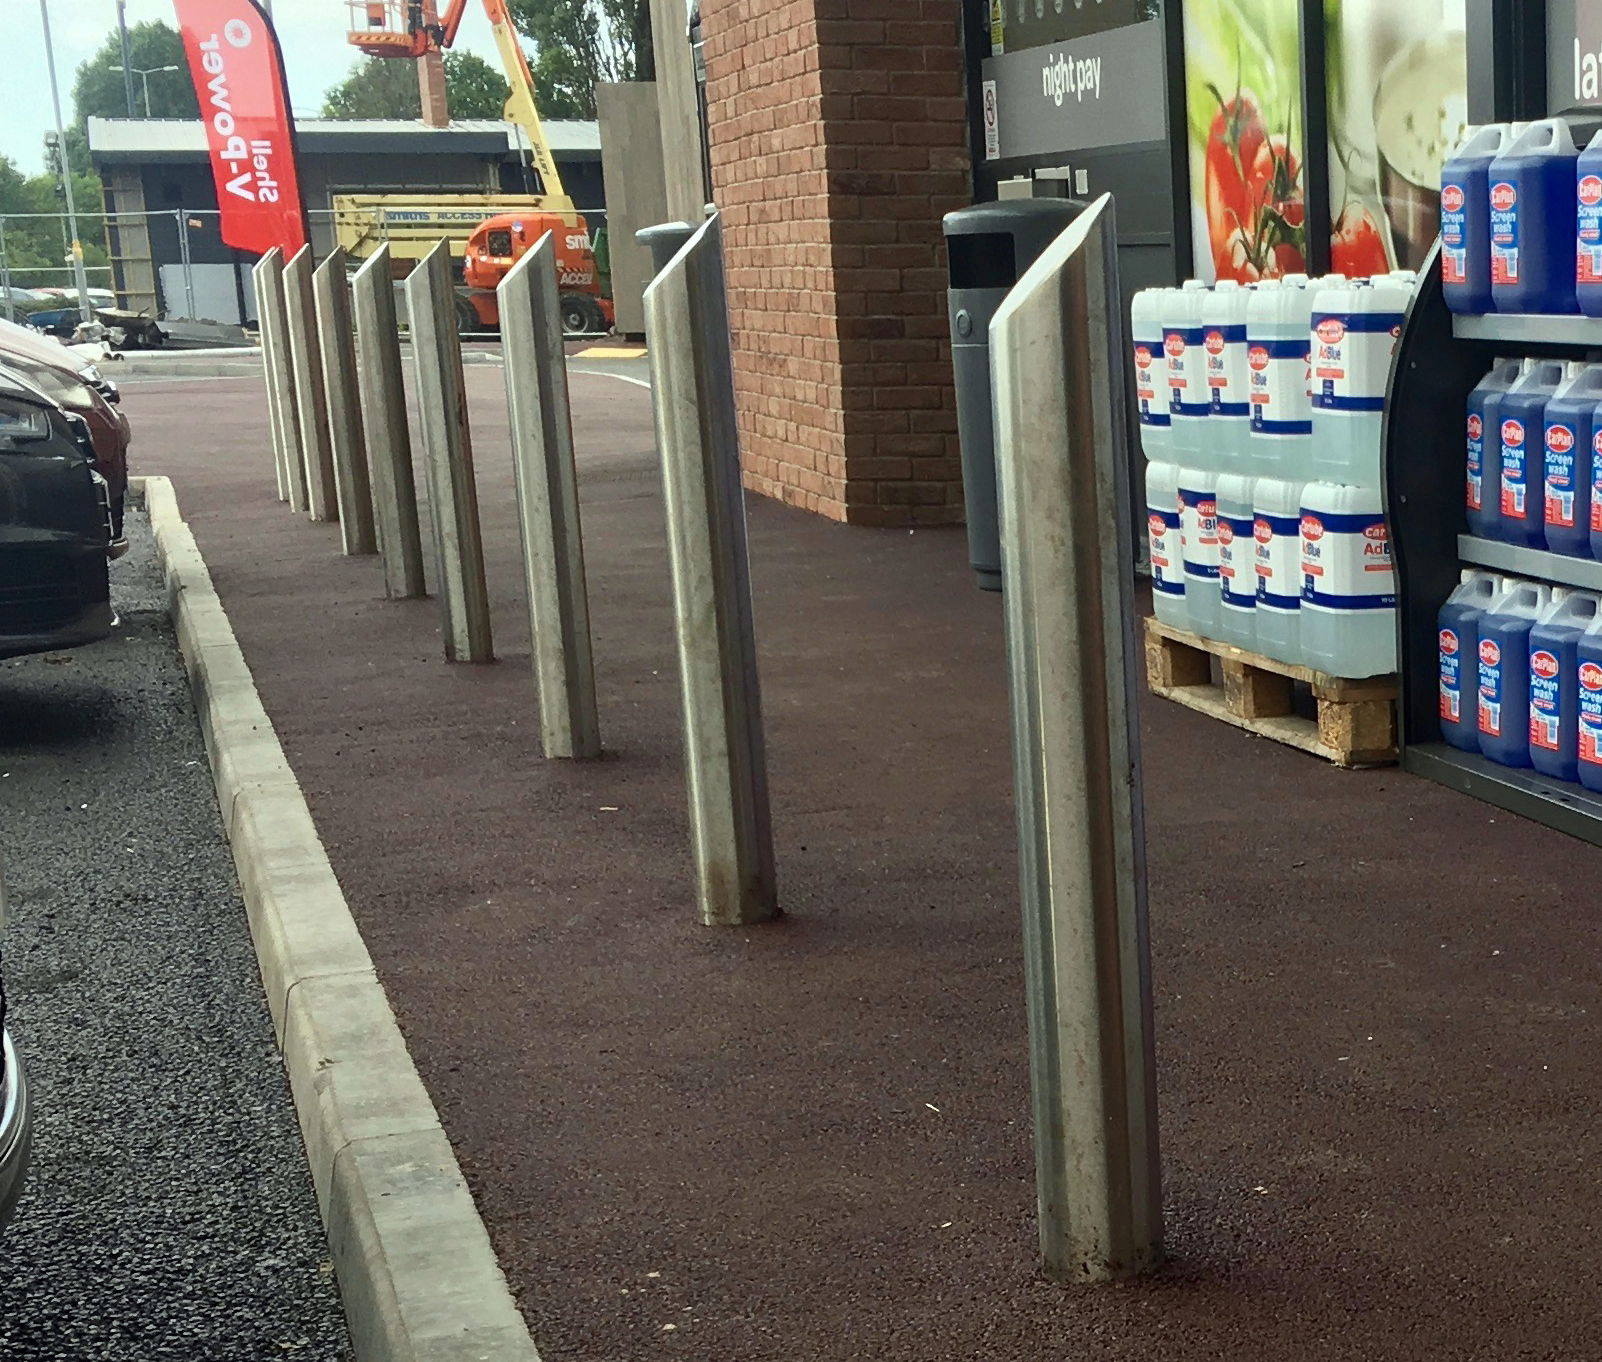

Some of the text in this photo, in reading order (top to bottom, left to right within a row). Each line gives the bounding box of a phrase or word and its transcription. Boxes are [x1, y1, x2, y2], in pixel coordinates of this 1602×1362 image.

[1042, 53, 1101, 106] night pay
[1579, 184, 1602, 198] CarPlan
[1545, 451, 1573, 466] Screen
[1549, 465, 1568, 475] wash
[1531, 675, 1558, 692] Screen
